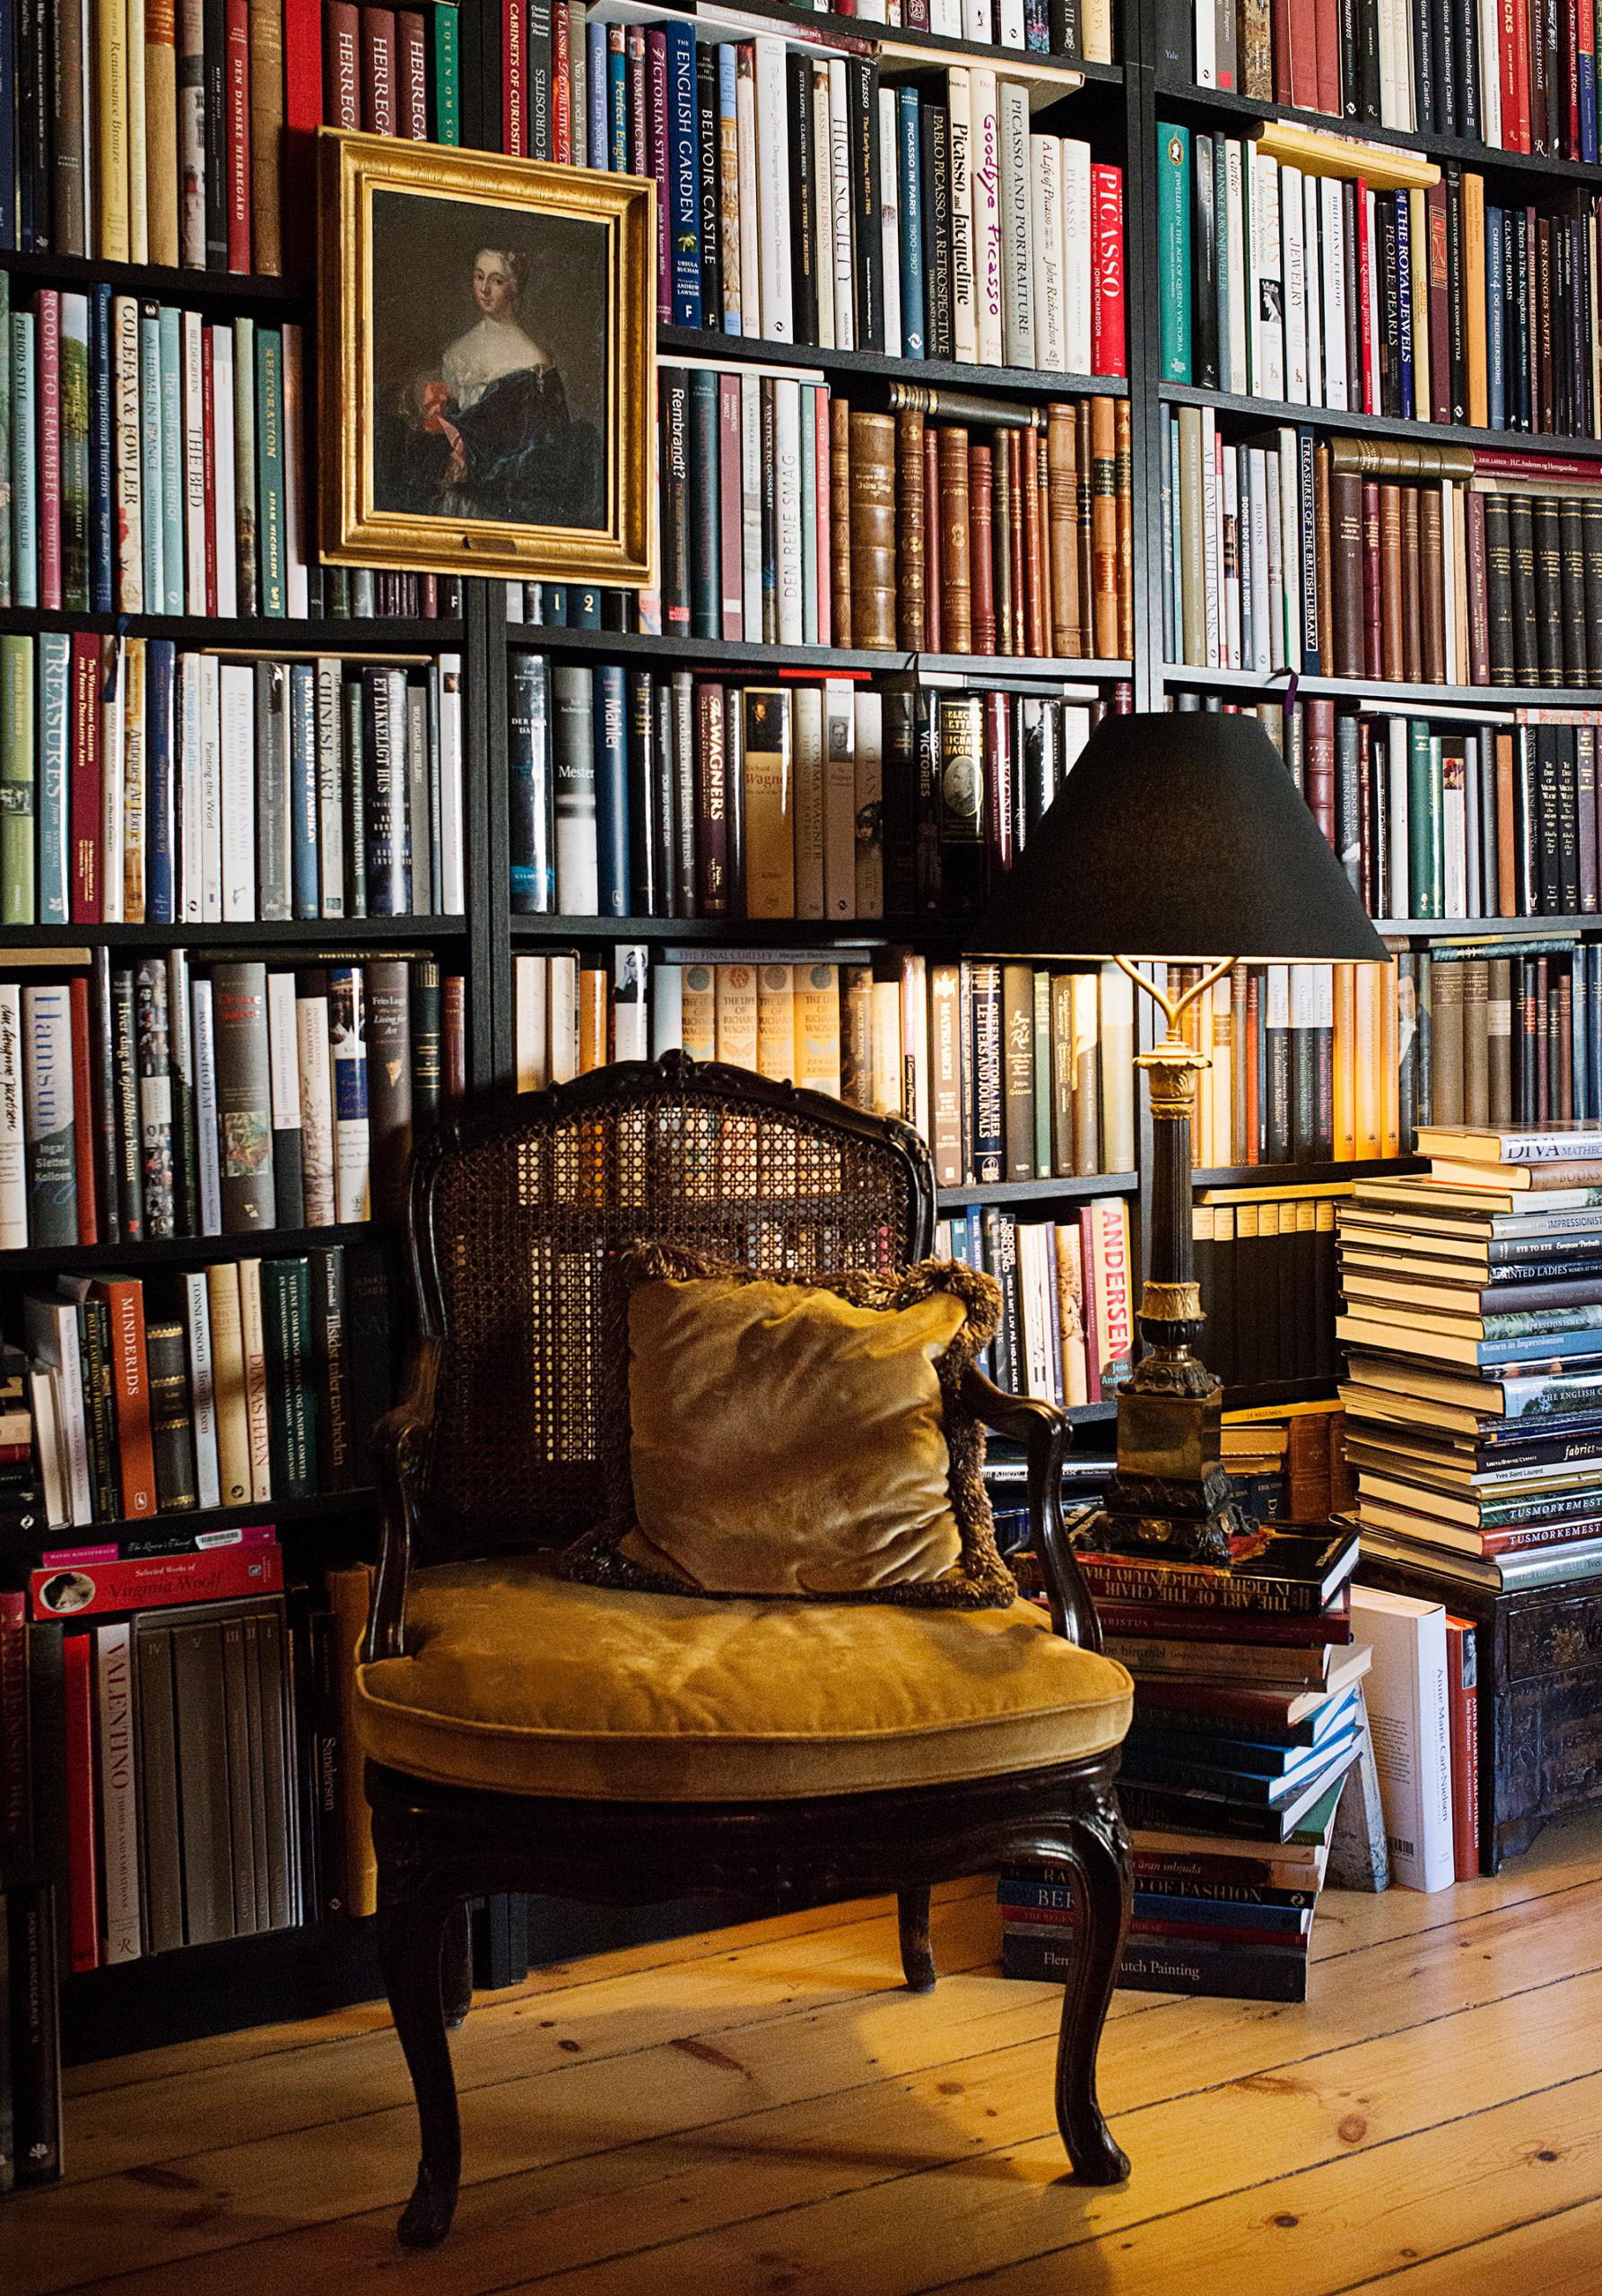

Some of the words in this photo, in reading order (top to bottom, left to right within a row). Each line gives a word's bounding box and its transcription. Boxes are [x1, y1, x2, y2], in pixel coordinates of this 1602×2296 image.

[510, 3, 518, 65] CABINETS
[1535, 10, 1543, 56] TIMELESS
[110, 41, 121, 117] Renaissance
[511, 69, 519, 88] OF
[575, 60, 584, 78] Nio
[595, 47, 603, 93] Ostindiskt
[861, 65, 871, 109] Picasso
[1584, 56, 1593, 90] NYTÅR
[576, 82, 584, 100] hus
[595, 100, 603, 119] Lars
[652, 48, 666, 135] VICTORIAN
[676, 51, 692, 132] ENGLISH
[235, 91, 243, 139] DANSKE
[576, 104, 585, 123] och
[576, 127, 583, 139] en
[819, 94, 827, 142] CLASSIC
[112, 120, 121, 163] Bronze
[594, 122, 604, 156] Sjöberg
[701, 109, 714, 187] BELVOIR
[833, 119, 849, 183] HIGH
[907, 122, 916, 168] PICASSO
[933, 115, 945, 158] PABLO
[1043, 142, 1052, 152] A
[1216, 144, 1224, 160] DE
[655, 140, 665, 183] STYLE
[820, 146, 828, 203] INTERIOR
[863, 153, 871, 176] Years,
[909, 170, 916, 182] IN
[953, 123, 968, 192] Picasso
[1042, 155, 1053, 174] Life
[236, 145, 245, 221] HERREGÅRD
[680, 141, 693, 223] GARDEN
[909, 185, 917, 216] PARIS
[935, 161, 946, 222] PICASSO:
[1041, 177, 1054, 186] of
[1216, 163, 1226, 208] DANSKE
[953, 196, 962, 209] and
[977, 114, 999, 208] Goodbye
[988, 225, 1001, 316] Picasso
[1043, 187, 1054, 225] Picasso
[1176, 216, 1182, 226] IN
[703, 195, 716, 265] CASTLE
[821, 205, 830, 251] DESIGN
[835, 187, 851, 284] SOCIETY
[936, 225, 945, 236] A
[1100, 172, 1120, 298] PICASSO
[1397, 207, 1407, 240] THE
[952, 213, 971, 305] Jacqueline
[1044, 257, 1055, 283] John
[1176, 265, 1182, 277] OF
[1217, 212, 1228, 291] KRONJUVELER
[1399, 244, 1409, 298] ROYAL
[936, 239, 949, 353] RETROSPECTIVE
[1047, 286, 1058, 345] Richardson
[1494, 293, 1500, 306] OG
[1518, 281, 1527, 324] Kingdom
[43, 297, 57, 361] ROOMS
[1400, 300, 1411, 362] JEWELS
[123, 305, 137, 398] COLEFAX
[44, 372, 57, 395] TO
[124, 404, 135, 416] &
[44, 405, 57, 502] REMEMBER
[188, 426, 203, 465] THE
[672, 388, 685, 479] Rembrandt?
[124, 423, 138, 504] FOWLER
[1302, 443, 1312, 508] TREASURES
[189, 472, 203, 507] BED
[1241, 496, 1249, 524] BOOKS
[1304, 511, 1313, 526] OF
[1241, 526, 1250, 539] DO
[1305, 529, 1314, 550] THE
[1241, 542, 1250, 578] FURNISH
[1305, 553, 1315, 595] BRITISH
[554, 594, 560, 611] 1
[584, 595, 594, 613] 2
[1242, 588, 1251, 614] ROOM
[1306, 599, 1316, 646] LIBRARY
[373, 678, 386, 693] ET
[320, 672, 334, 757] CHINESE
[605, 699, 622, 751] Mahler
[709, 696, 722, 725] The
[374, 697, 389, 765] LYKKELIGT
[130, 729, 141, 782] Antiques
[710, 725, 724, 820] WAGNERS
[131, 787, 141, 801] At
[321, 764, 334, 804] ART
[378, 769, 390, 793] HUS
[131, 807, 142, 841] Home
[940, 1003, 952, 1080] MATRIARCH
[977, 1004, 988, 1055] LETTERS
[989, 1003, 998, 1041] QUEEN
[34, 996, 62, 1127] Hamsun
[978, 1055, 988, 1081] AND
[990, 1043, 999, 1097] VICTORIA
[978, 1081, 989, 1138] JOURNALS
[990, 1099, 999, 1109] IN
[990, 1111, 1000, 1137] HER
[1000, 1218, 1008, 1272] RØNLUND
[1007, 1223, 1015, 1265] DIDDER
[1102, 1210, 1129, 1361] ANDERSEN
[1537, 1265, 1568, 1276] LADIES
[121, 1298, 139, 1396] MINDERIDS
[1009, 1331, 1017, 1342] PÅ
[1481, 1342, 1507, 1352] Women
[1508, 1341, 1515, 1349] in
[1517, 1336, 1563, 1348] Impressionism
[1563, 1444, 1595, 1461] fabrics
[1105, 1580, 1153, 1598] CHAIR
[1163, 1588, 1190, 1604] THE
[1196, 1591, 1215, 1605] OF
[1220, 1595, 1249, 1611] ART
[1258, 1596, 1290, 1612] THE
[1436, 1668, 1446, 1703] Anne
[106, 1641, 129, 1790] VALENTINO
[1438, 1706, 1447, 1743] Marie
[1439, 1745, 1450, 1822] Carl-Nielsen
[1149, 1878, 1172, 1894] OF
[1180, 1879, 1262, 1902] FASHION
[1150, 1961, 1200, 1980] Painting
